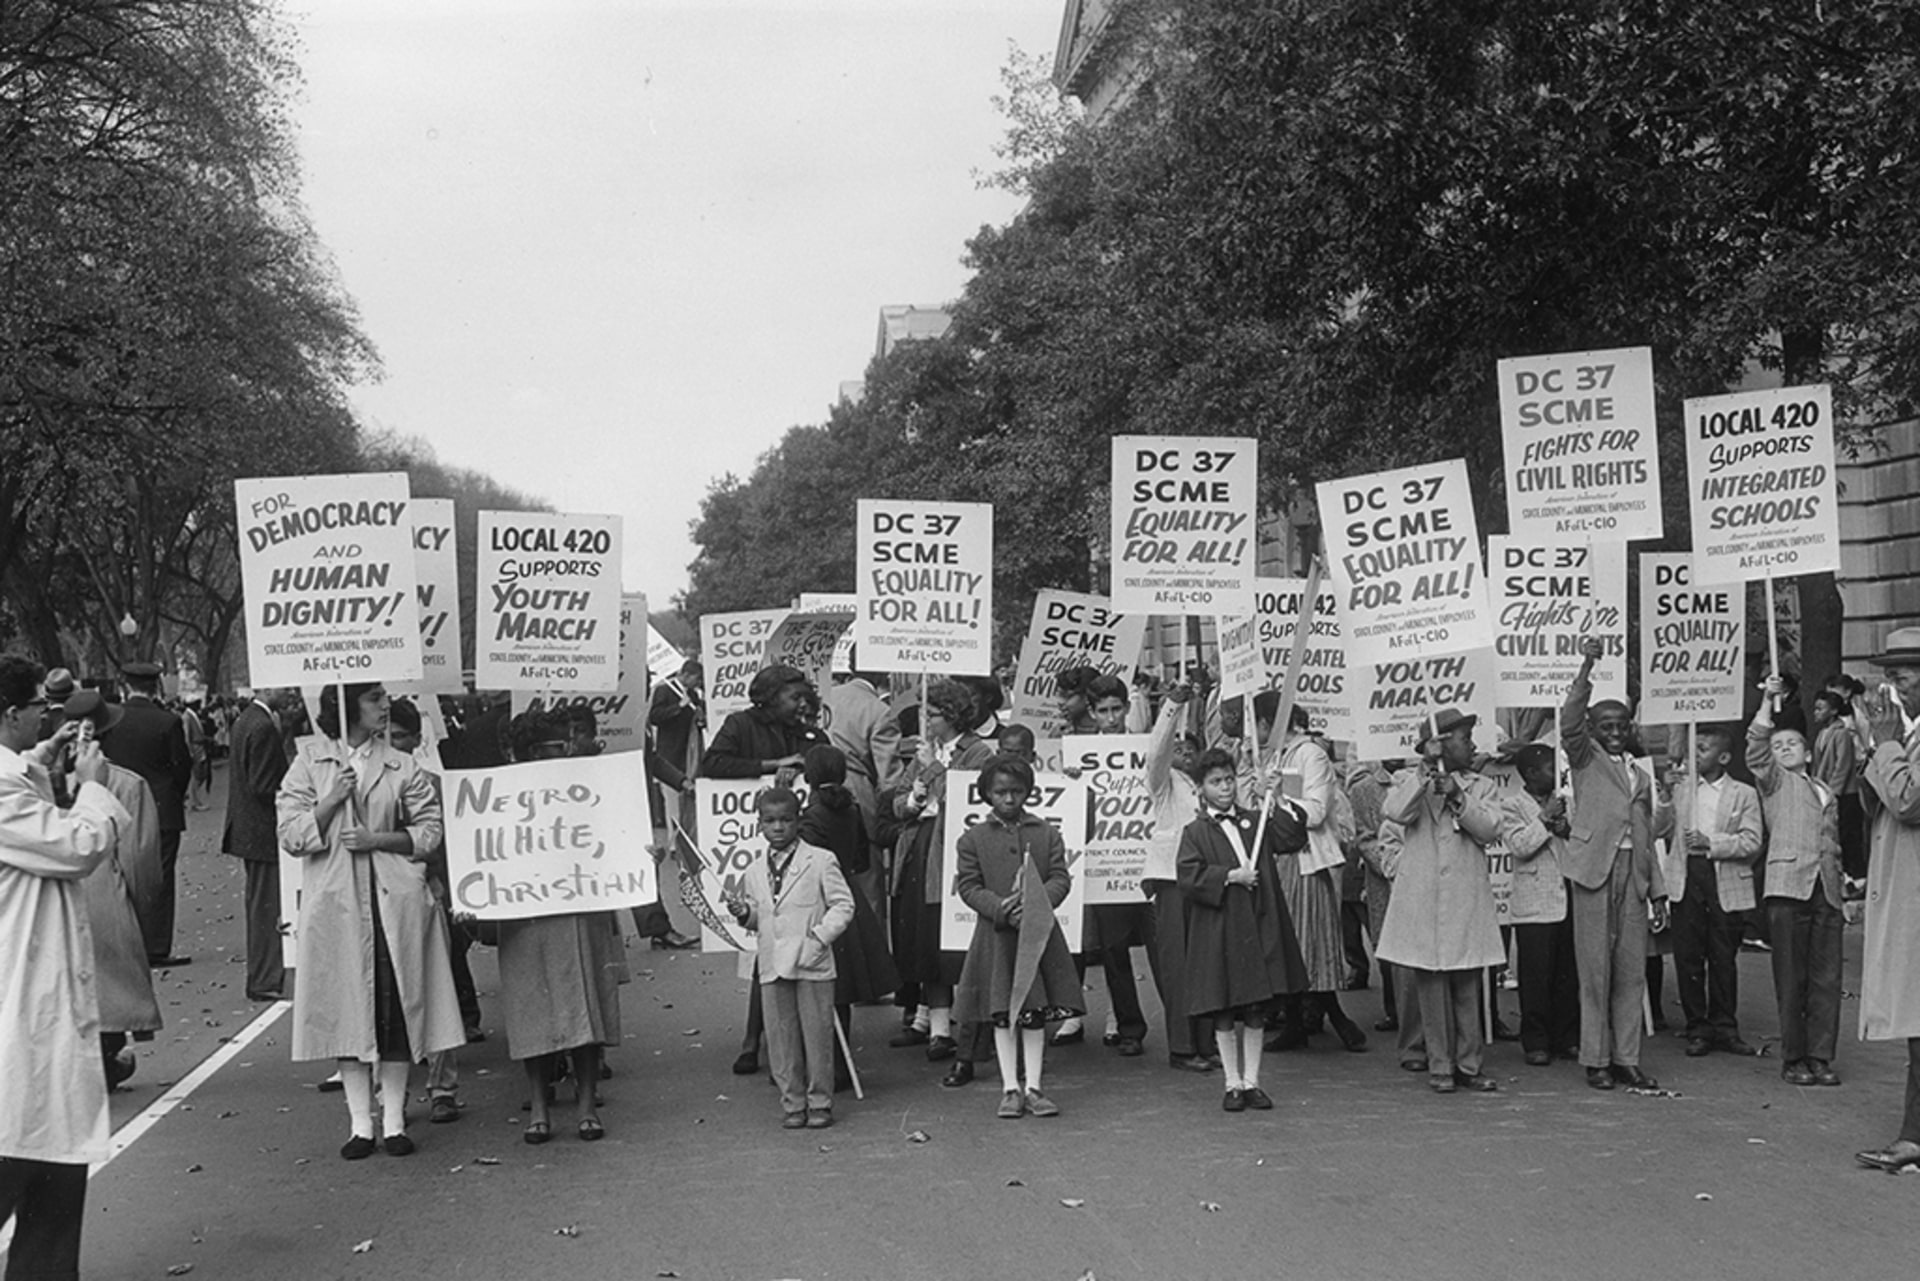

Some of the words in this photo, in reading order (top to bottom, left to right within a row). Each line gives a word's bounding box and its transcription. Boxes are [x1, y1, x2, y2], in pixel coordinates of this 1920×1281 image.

[1516, 370, 1564, 396] DC
[1576, 364, 1616, 390] 37
[1518, 398, 1614, 428] SCME
[1700, 407, 1766, 439] LOCAL
[1771, 400, 1820, 429] 420
[1136, 450, 1180, 472] DC
[1192, 451, 1236, 472] 37
[1523, 431, 1594, 466] FIGHTS
[1598, 429, 1640, 452] FOR
[1710, 434, 1814, 474] SUPPORTS
[1516, 466, 1566, 492] CIVIL
[1572, 460, 1648, 489] RIGHTS
[1702, 464, 1827, 501] INTEGRATED
[1134, 480, 1230, 502] SCME
[1343, 487, 1386, 514] DC
[1402, 476, 1445, 504] 37
[251, 493, 296, 518] FOR
[1710, 496, 1820, 530] SCHOOLS
[247, 501, 406, 552] DEMOCRACY
[874, 513, 914, 534] DC
[924, 514, 962, 536] 37
[1126, 507, 1247, 538] EQUALITY
[1346, 508, 1452, 548] SCME
[313, 544, 362, 558] AND
[492, 526, 559, 551] LOCAL
[563, 529, 610, 554] 420
[873, 541, 958, 564] SCME
[1122, 540, 1178, 564] FOR
[1186, 538, 1247, 566] ALL!
[498, 559, 602, 583] SUPPORTS
[1342, 536, 1467, 584] EQUALITY
[1505, 548, 1545, 568] DC
[1554, 548, 1588, 567] 37
[269, 563, 390, 593] HUMAN
[872, 568, 982, 596] EQUALITY
[1350, 580, 1402, 610] FOR
[1412, 562, 1474, 601] ALL!
[1504, 576, 1590, 597] SCME
[1656, 565, 1688, 586] DC
[262, 592, 405, 627] DIGNITY!
[491, 582, 590, 613] YOUTH
[1255, 593, 1304, 614] LOCA
[1314, 595, 1336, 616] 42
[1657, 593, 1729, 616] SCME
[495, 612, 597, 642] MARCH
[870, 598, 917, 622] FOR
[926, 598, 981, 629] ALL!
[1048, 602, 1085, 624] DC
[1090, 608, 1124, 629] 37
[1500, 600, 1580, 636] Fights
[712, 622, 742, 638] DC
[750, 620, 773, 634] 37
[1041, 627, 1116, 652] SCME
[1654, 620, 1740, 648] EQUALITY
[324, 640, 361, 652] MUNICIPAL
[362, 637, 404, 650] EMPLOYEES
[714, 641, 762, 658] SCM
[782, 638, 802, 652] OF
[803, 632, 835, 654] GOD
[1496, 634, 1548, 656] CIVIL
[715, 661, 759, 684] EQUA
[1375, 656, 1466, 684] YOUTH
[1650, 650, 1690, 674] FOR
[1696, 646, 1740, 676] ALL!
[712, 683, 745, 700] FOR
[1024, 676, 1058, 698] CIVI
[1258, 671, 1344, 694] SCOOLS
[1369, 682, 1476, 709] MARCH
[1080, 752, 1147, 770] SCM
[1095, 796, 1153, 816] OUT
